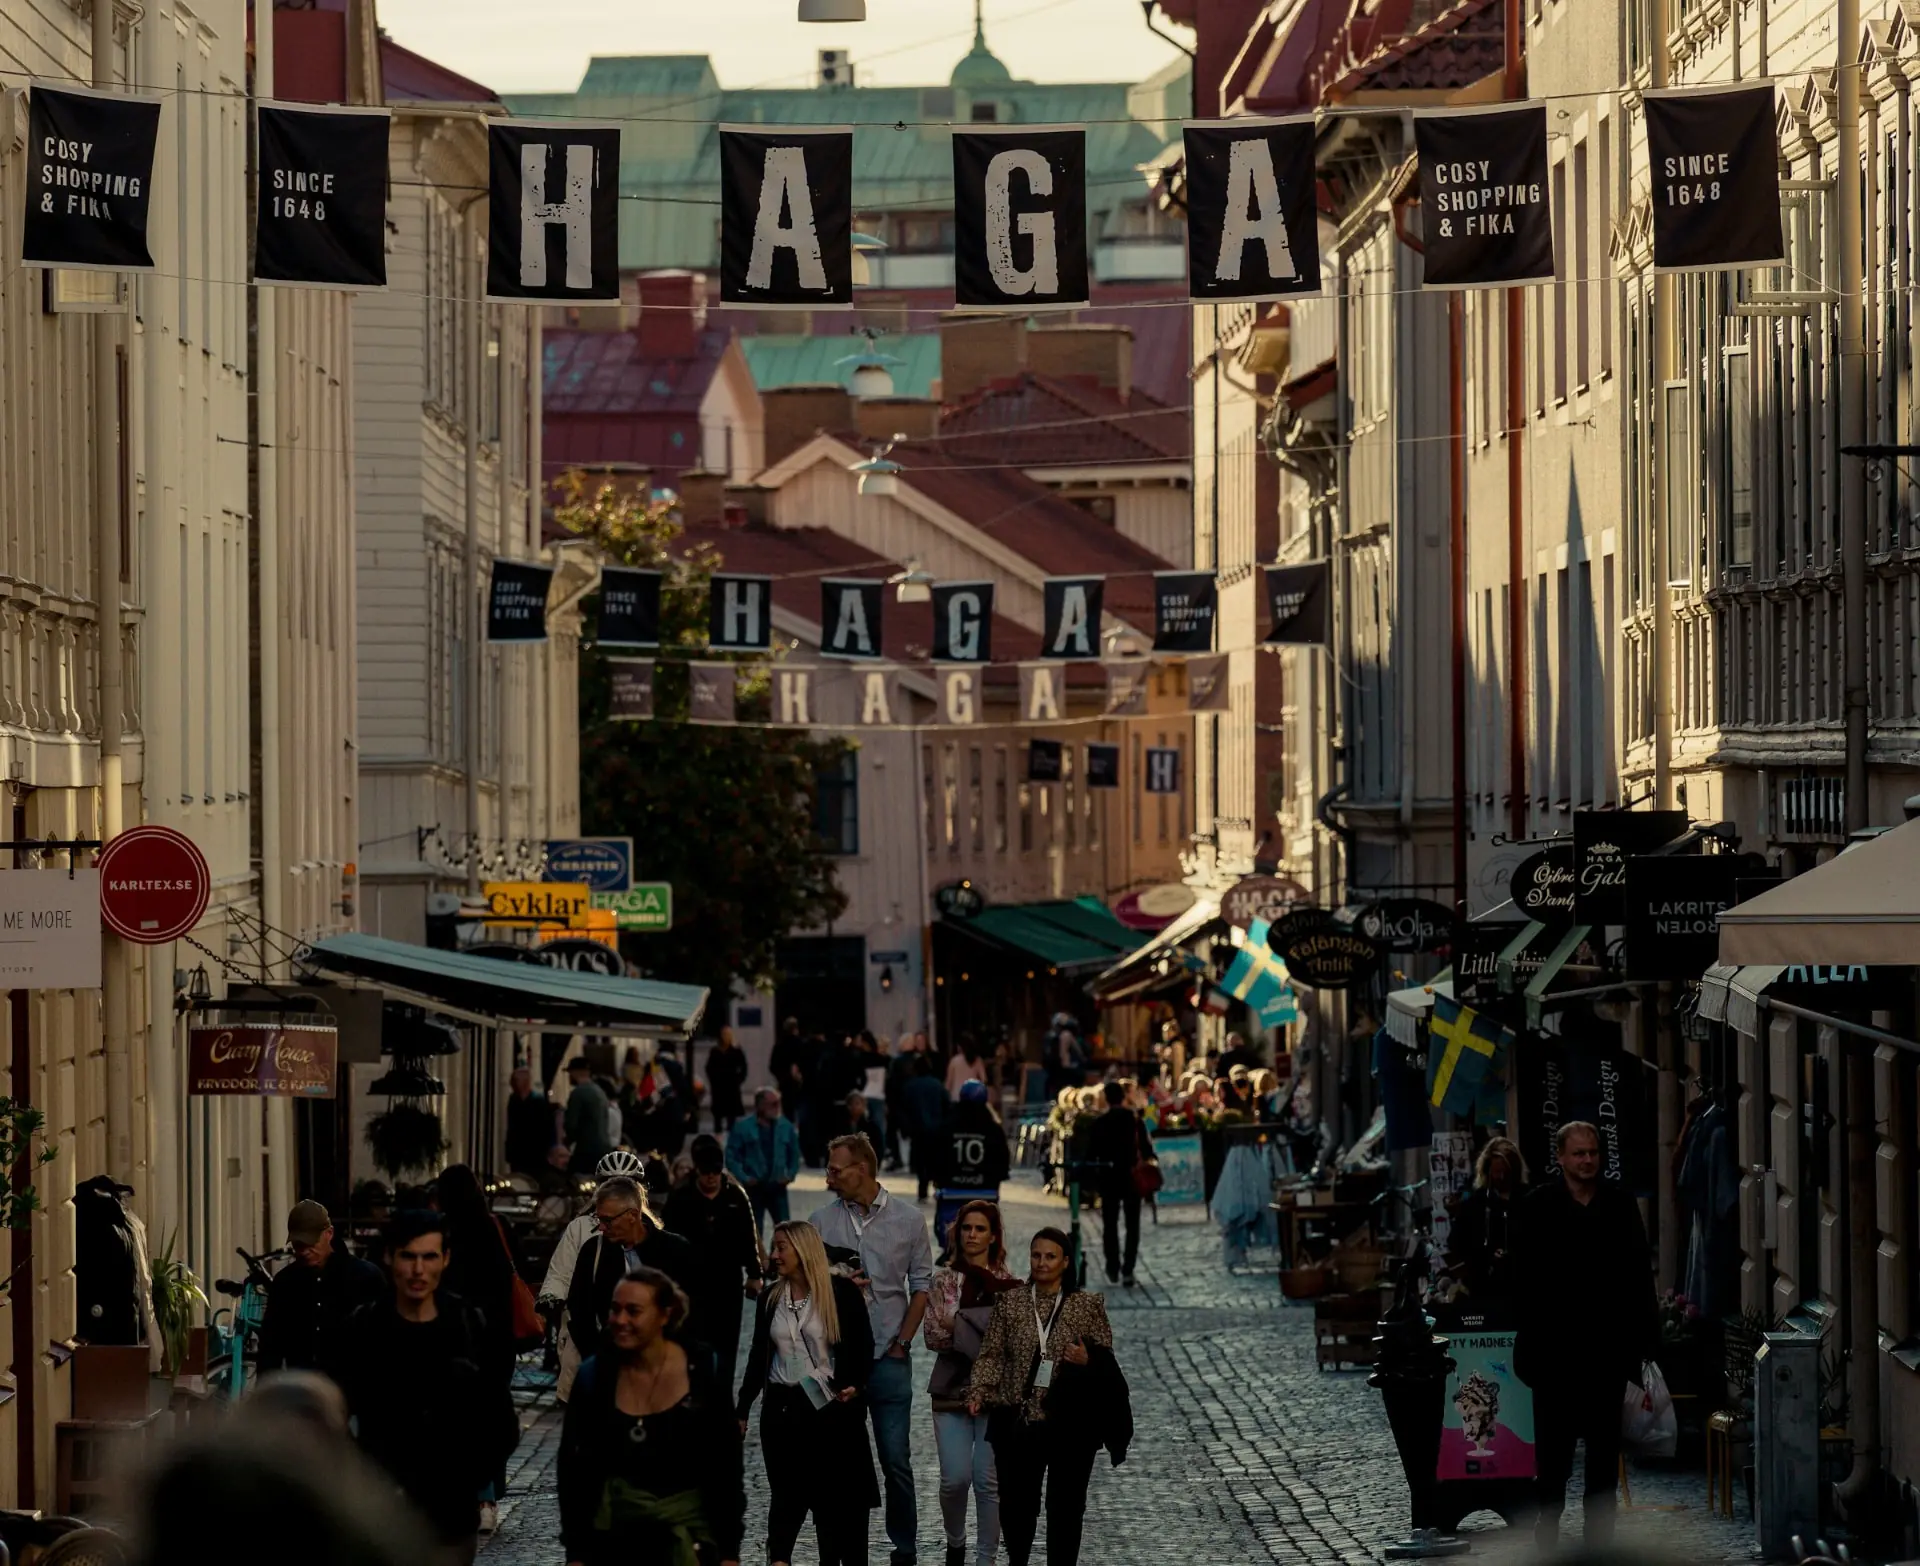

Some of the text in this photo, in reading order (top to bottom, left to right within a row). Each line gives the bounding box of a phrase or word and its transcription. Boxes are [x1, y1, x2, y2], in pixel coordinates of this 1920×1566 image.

[44, 136, 94, 164] COSY
[1435, 160, 1490, 185] COSY
[1665, 153, 1731, 178] SINCE
[41, 164, 141, 198] SHOPPING
[273, 168, 335, 194] SINCE
[1666, 180, 1722, 206] 1648
[40, 193, 113, 221] & FIKA
[272, 197, 327, 221] 1648
[1437, 183, 1542, 213] SHOPPING
[1438, 214, 1515, 238] & FIKA
[1587, 855, 1623, 863] HAGA
[109, 879, 193, 891] KARLTEX.SE
[3, 910, 73, 929] ME MORE
[1648, 901, 1728, 915] LAKRITS
[210, 1031, 316, 1074] Curry House
[1596, 1060, 1621, 1181] Svensk Design
[952, 1139, 986, 1165] 10
[1470, 1337, 1516, 1348] MADNES
